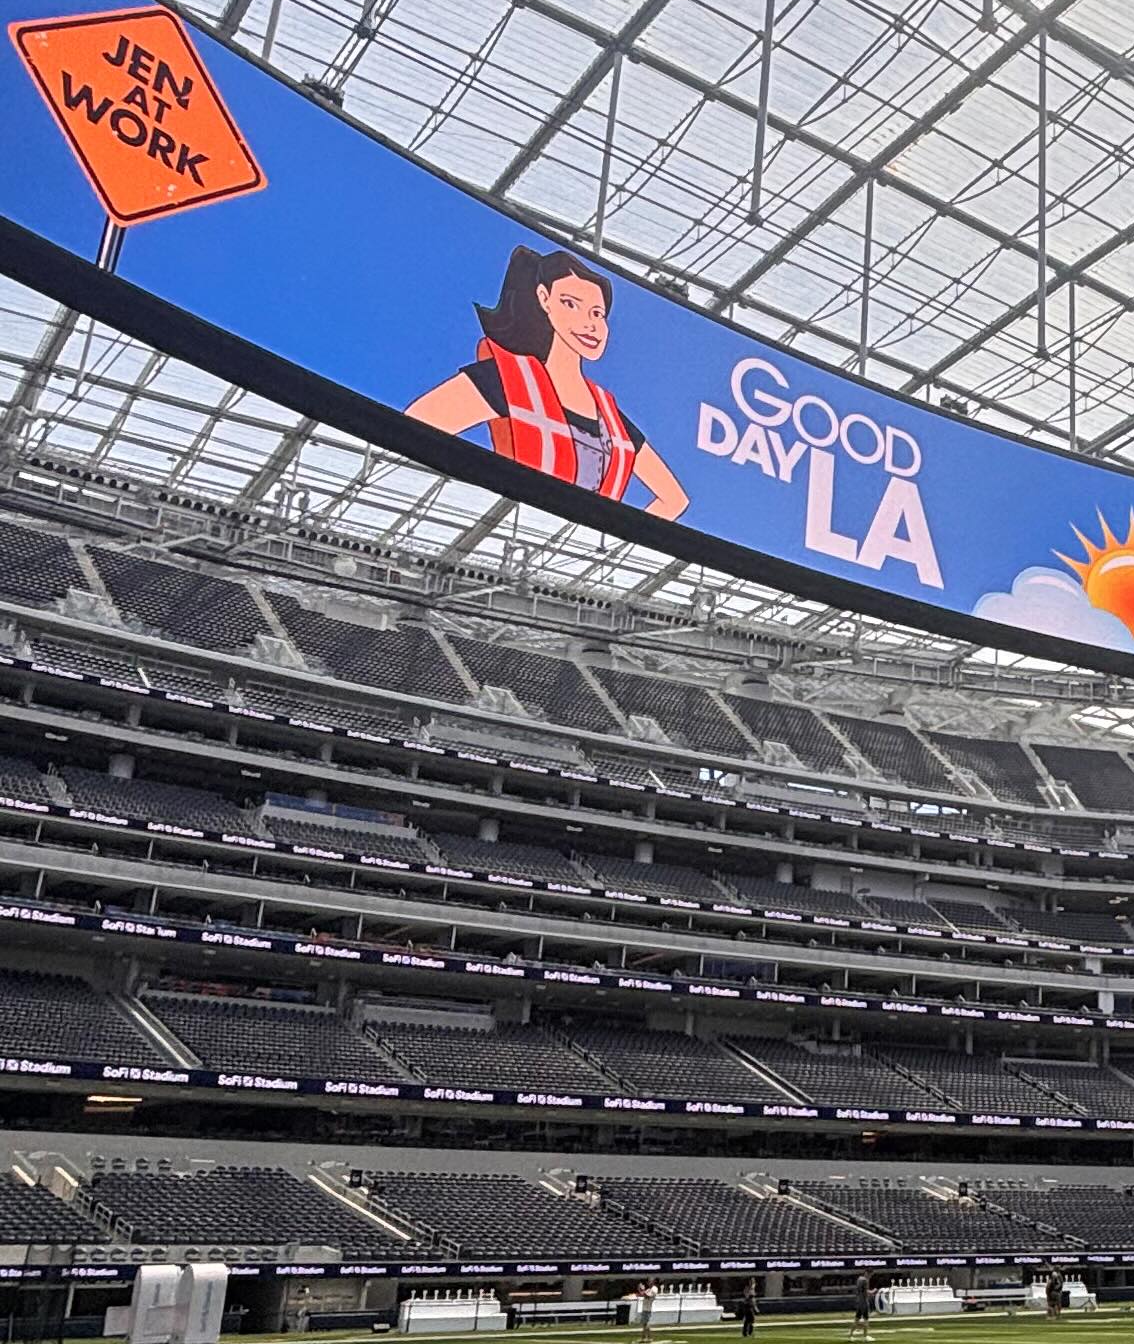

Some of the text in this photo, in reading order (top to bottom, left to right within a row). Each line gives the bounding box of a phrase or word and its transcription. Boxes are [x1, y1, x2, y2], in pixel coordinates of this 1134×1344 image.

[102, 35, 193, 110] JEN
[122, 85, 172, 124] AT
[62, 70, 210, 188] WORK
[731, 358, 922, 477] GOOD
[697, 402, 944, 590] DAY LA
[31, 910, 75, 924] Stadium
[101, 919, 124, 930] SoFi
[102, 1066, 189, 1082] SoFi Stadium
[217, 1074, 297, 1089] SoFi Stadium
[324, 1081, 398, 1095] SoFi Stadium
